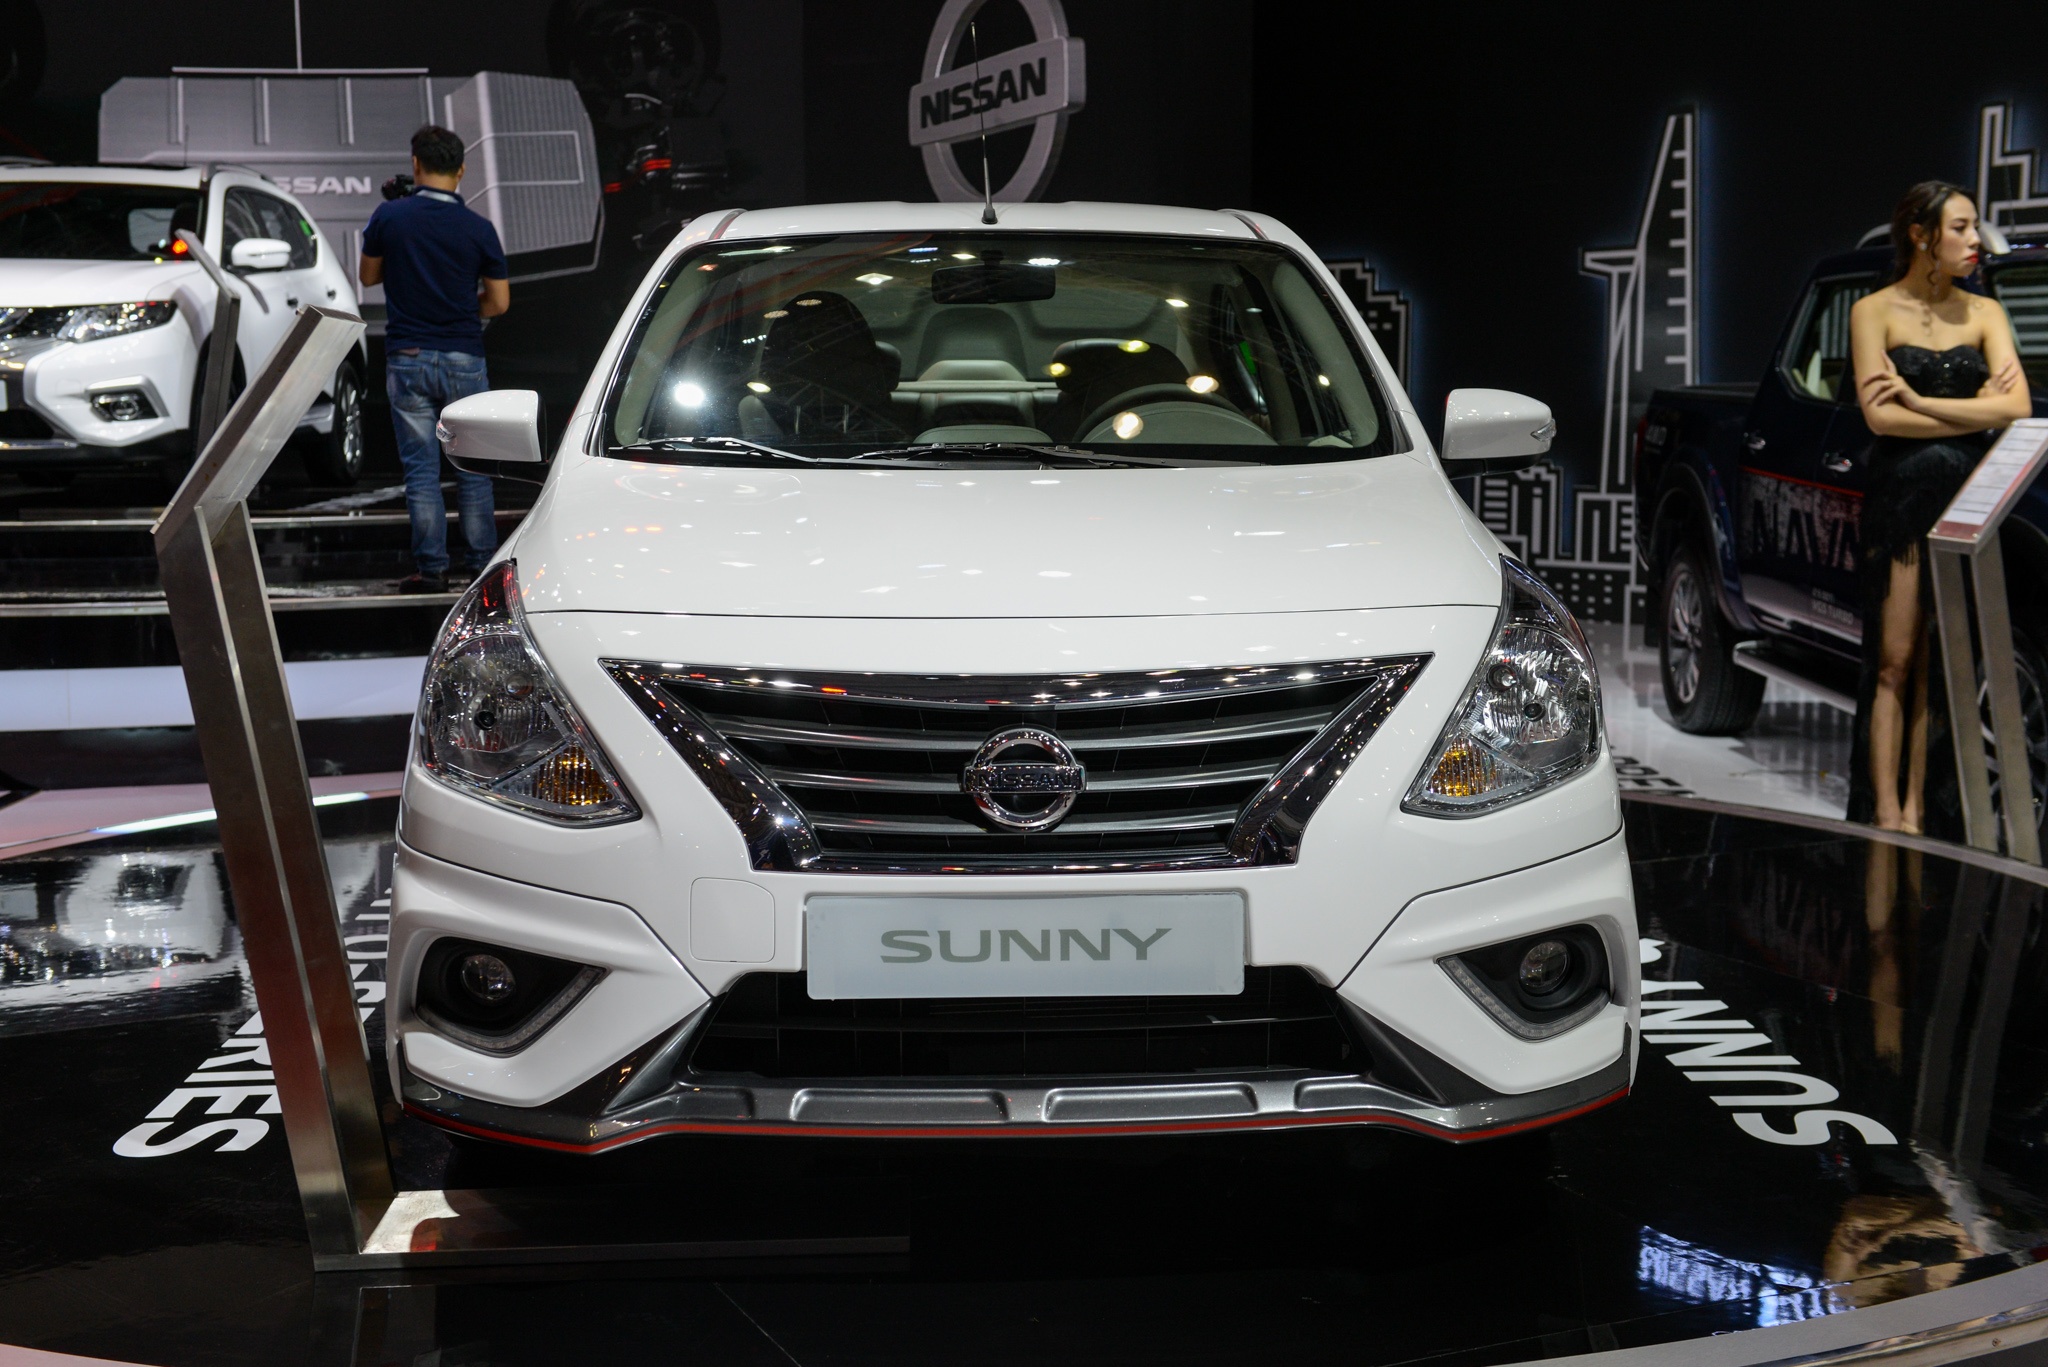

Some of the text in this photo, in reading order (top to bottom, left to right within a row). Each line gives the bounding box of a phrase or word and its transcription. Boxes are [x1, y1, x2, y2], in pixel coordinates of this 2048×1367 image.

[920, 57, 1047, 129] NISSAN
[272, 176, 371, 194] SSAN
[978, 773, 1072, 788] NISSAN
[880, 928, 1173, 964] SUNNY
